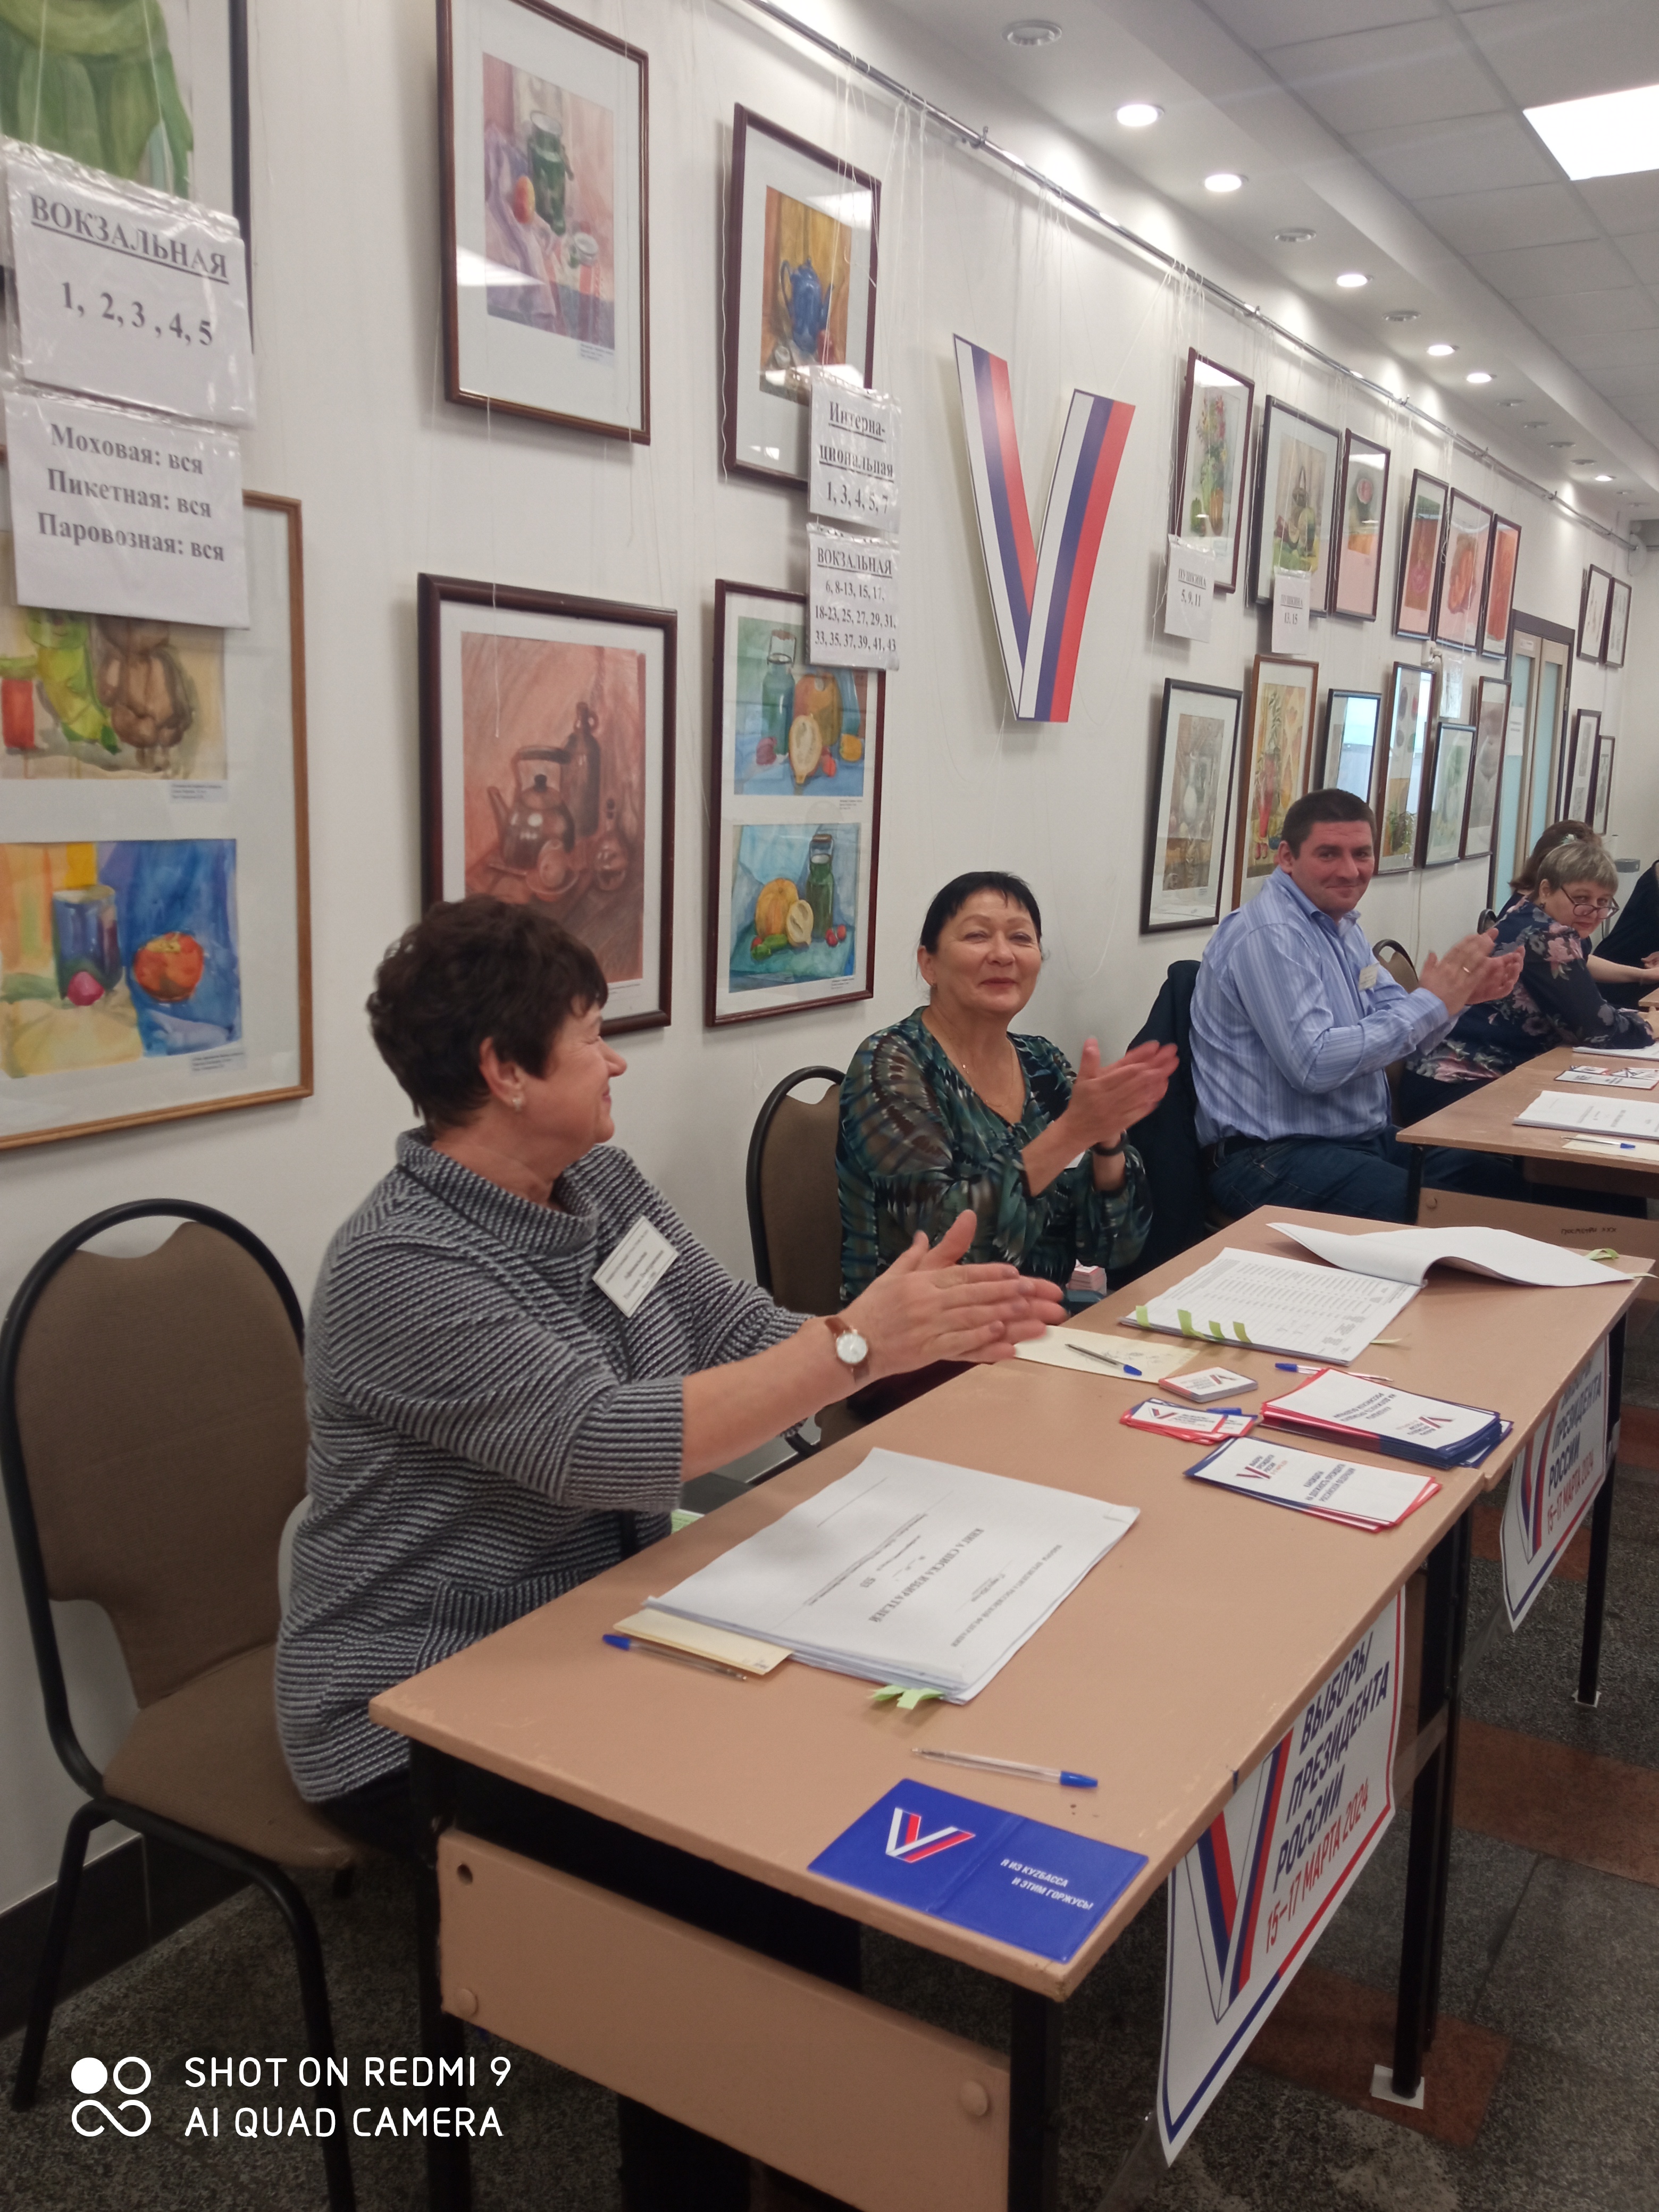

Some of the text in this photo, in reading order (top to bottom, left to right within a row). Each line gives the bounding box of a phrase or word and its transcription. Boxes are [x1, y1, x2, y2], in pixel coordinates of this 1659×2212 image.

[30, 193, 227, 278] ВОКЗАЛЬНАЯ
[62, 282, 84, 317] 1,
[199, 320, 212, 346] 5
[51, 424, 203, 475] Моховая: вся
[819, 444, 893, 477] циональная
[47, 468, 212, 518] Пикетная: вся
[828, 481, 836, 505] 1,
[841, 484, 851, 508] 3,
[855, 488, 865, 511] 4,
[37, 512, 224, 562] Паровозная: вся
[817, 547, 892, 575] ВОКЗАЛЬНАЯ
[835, 581, 856, 598] 8-13,
[859, 584, 870, 600] 15,
[815, 630, 827, 646] 33,
[844, 633, 856, 649] 37,
[858, 635, 870, 651] 39,
[816, 605, 840, 623] 18-23,
[842, 608, 854, 624] 25,
[857, 610, 868, 626] 27,
[871, 612, 882, 628] 29,
[1548, 1431, 1580, 1497] РОССИИ
[923, 1548, 961, 1576] СПИСКА
[954, 1528, 985, 1548] КНИГА
[867, 1574, 931, 1623] ИЗБИРАТЕЛЕЙ
[1299, 1631, 1373, 1756] ВЫБОРЫ
[1286, 1660, 1389, 1824] ПРЕЗИДЕНТА
[1273, 1764, 1345, 1893] РОССИИ
[1302, 1815, 1341, 1902] МАРТА
[1342, 1778, 1368, 1842] 2024
[1008, 1862, 1023, 1871] ИЗ
[1011, 1877, 1021, 1886] И
[1020, 1881, 1047, 1895] ЭТИМ
